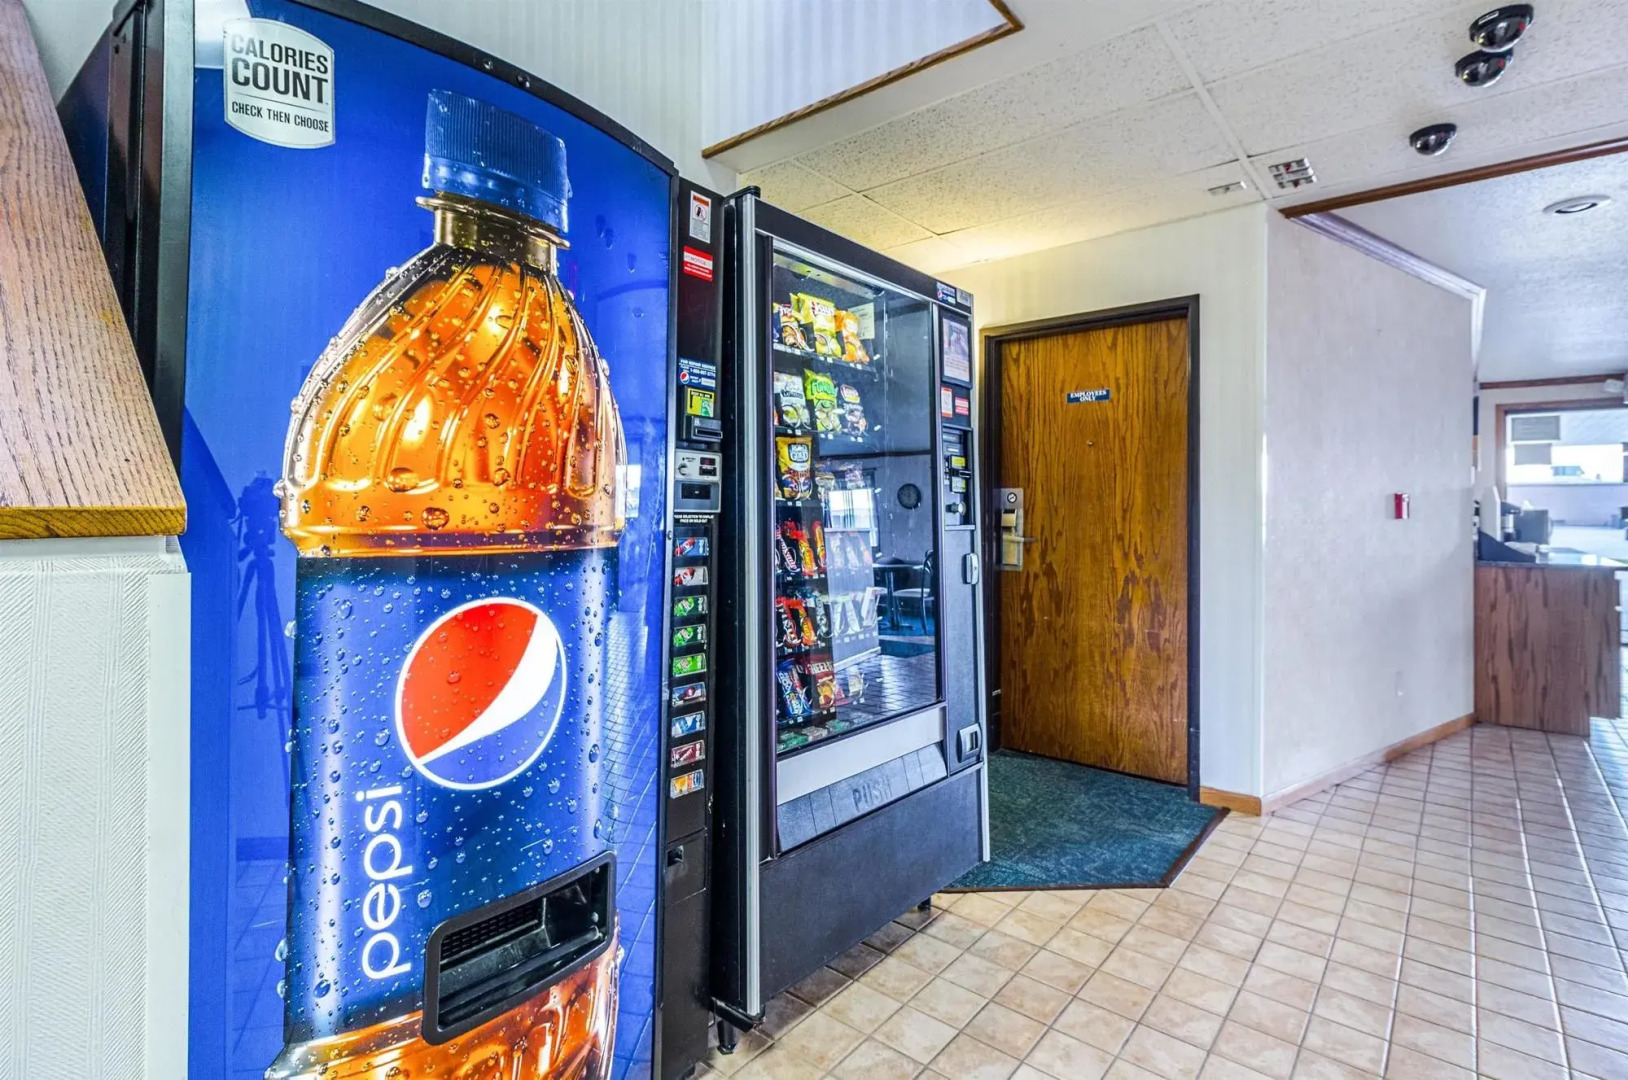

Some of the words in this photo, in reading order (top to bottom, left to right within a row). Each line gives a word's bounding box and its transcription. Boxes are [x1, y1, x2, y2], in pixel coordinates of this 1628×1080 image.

[231, 34, 329, 75] CALORIES
[231, 57, 329, 104] COUNT
[231, 101, 263, 118] CHECK
[267, 108, 291, 124] THEN
[294, 114, 329, 132] CHOOSE
[1070, 390, 1107, 398] EMPLOYEES
[852, 776, 893, 812] PUSH
[355, 784, 413, 980] pepsi
